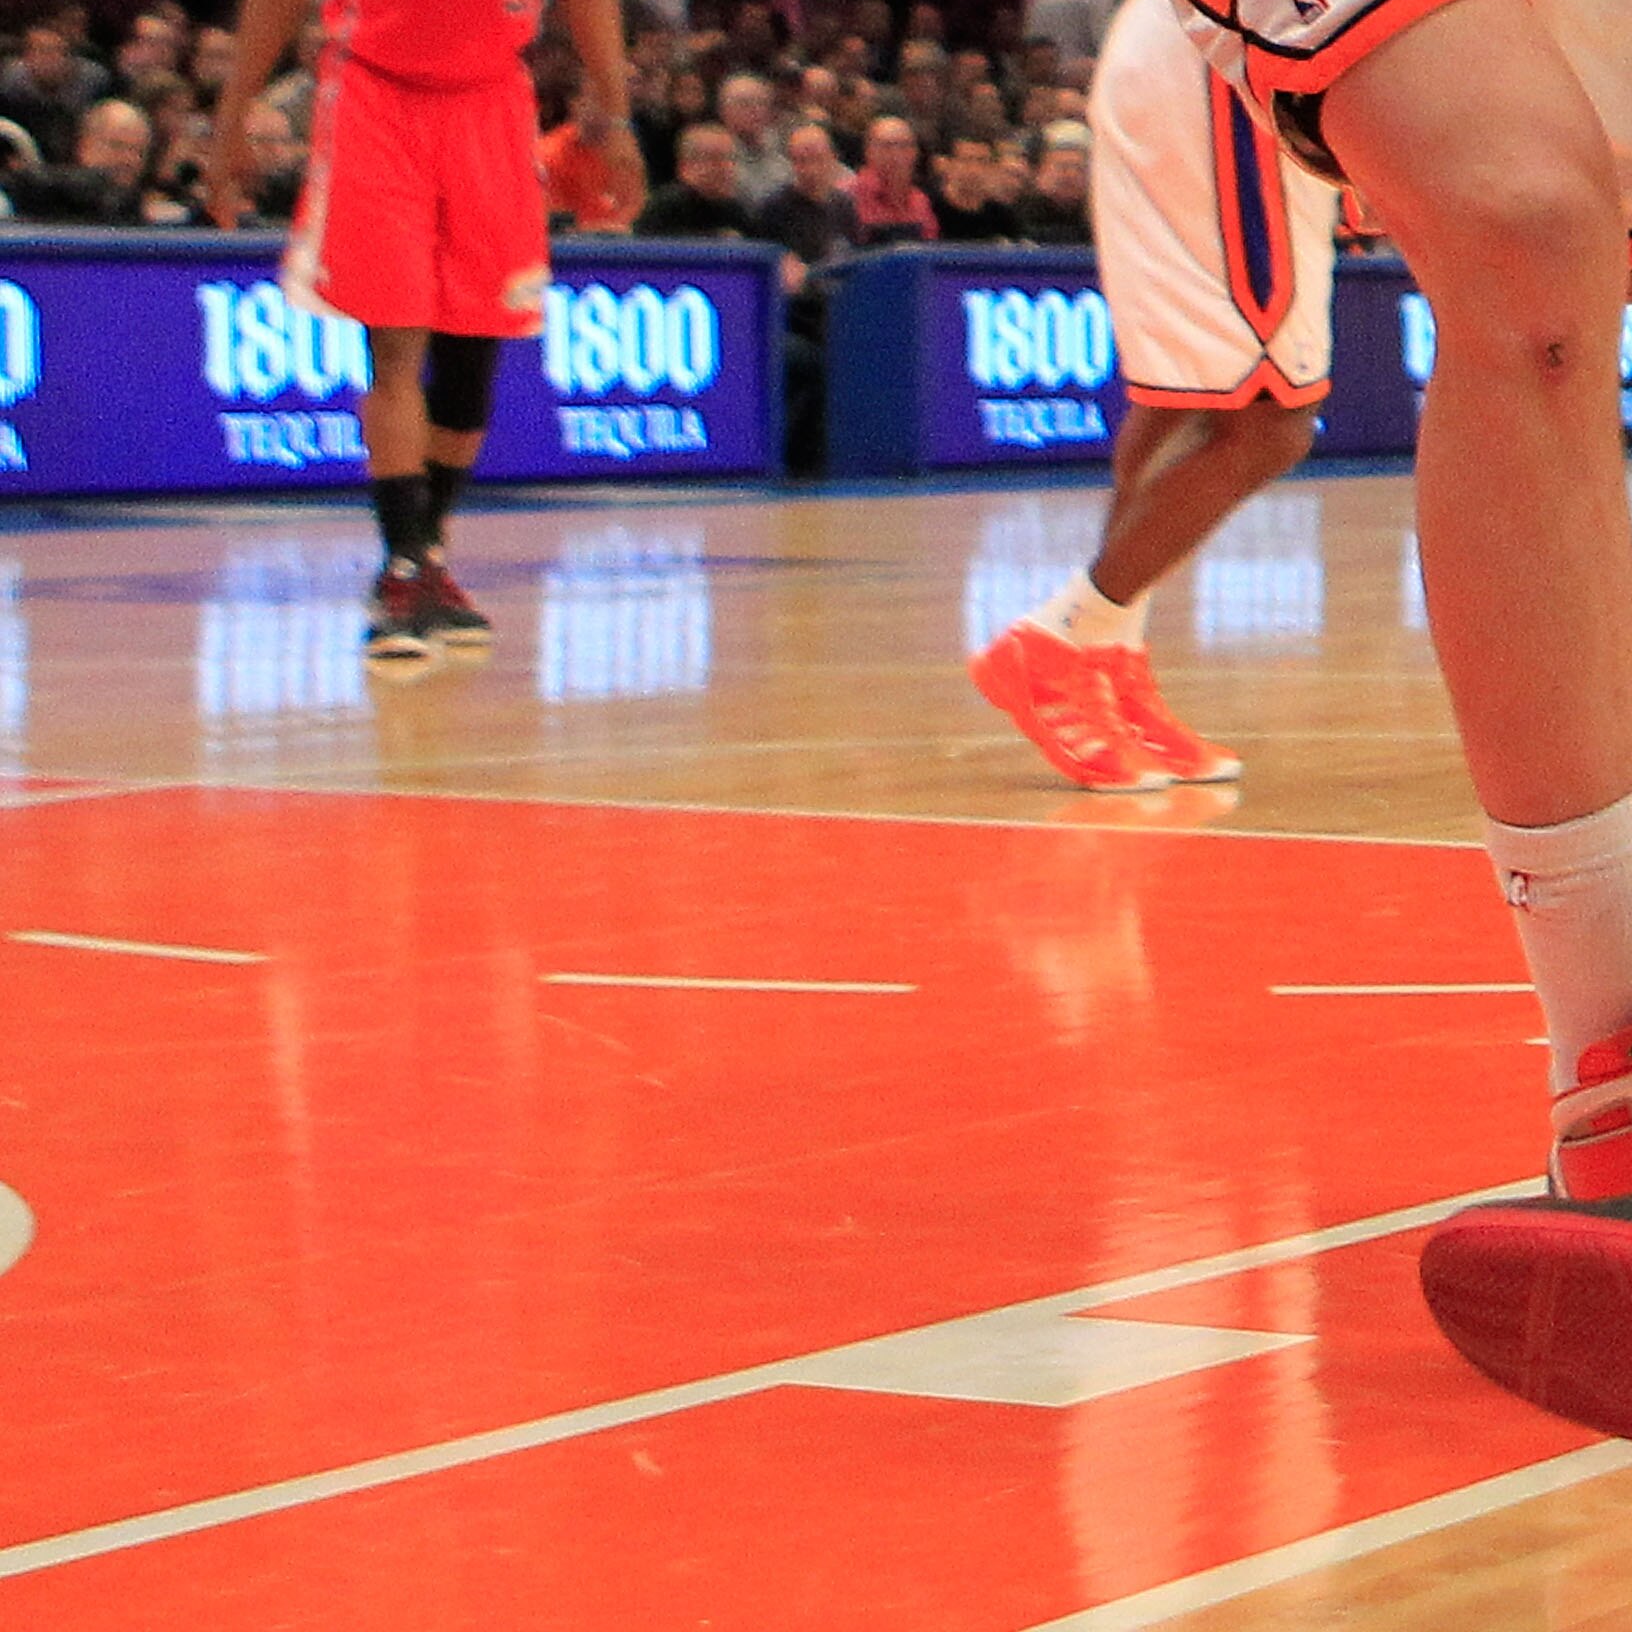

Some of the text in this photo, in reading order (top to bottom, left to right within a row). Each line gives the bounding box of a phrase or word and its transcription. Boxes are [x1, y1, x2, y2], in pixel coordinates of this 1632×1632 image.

[543, 282, 721, 397] 1800
[963, 287, 1116, 391] 1800
[558, 404, 709, 461] TEQUILA
[977, 397, 1110, 450] TEQUILA
